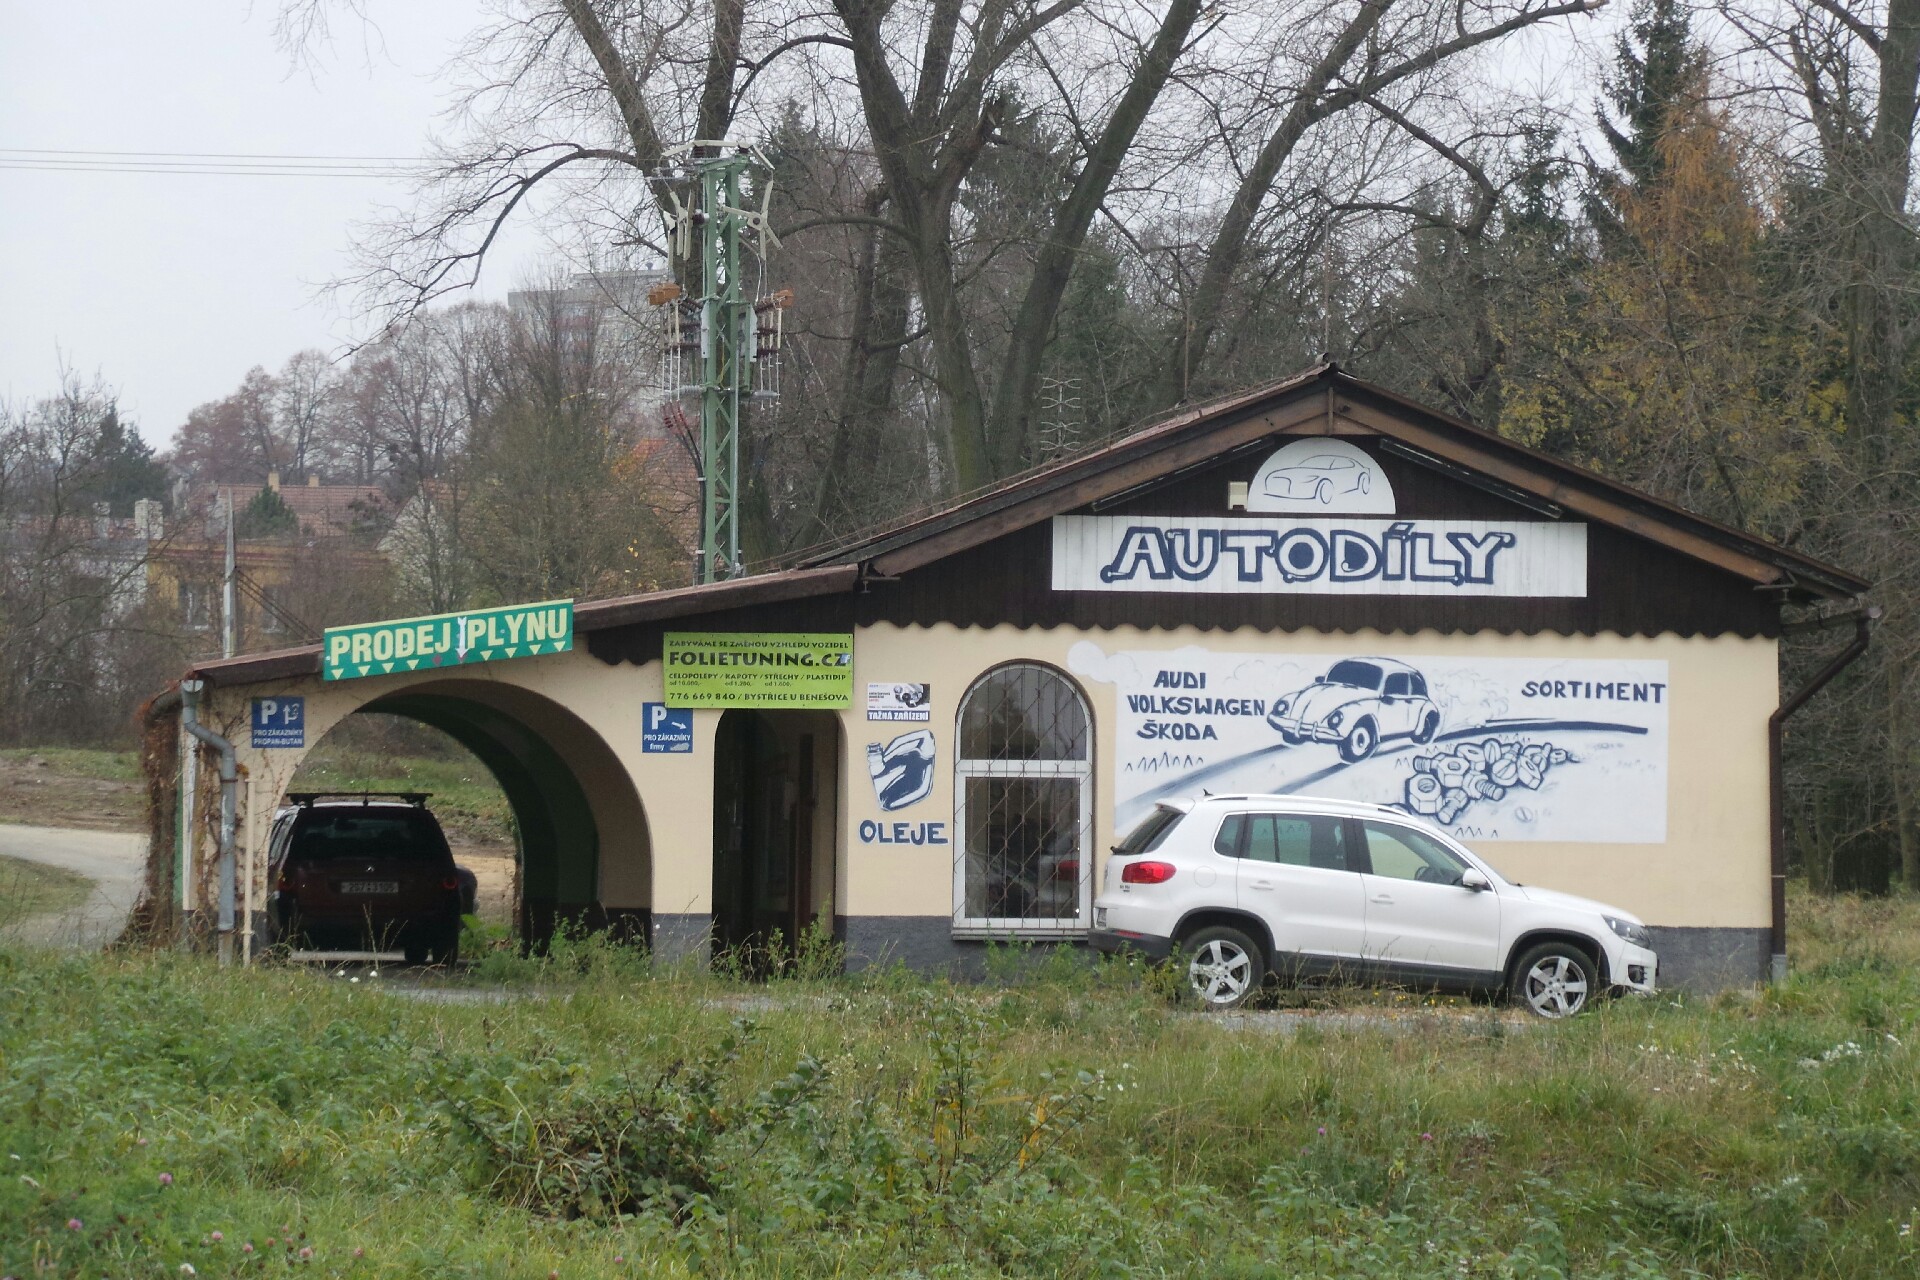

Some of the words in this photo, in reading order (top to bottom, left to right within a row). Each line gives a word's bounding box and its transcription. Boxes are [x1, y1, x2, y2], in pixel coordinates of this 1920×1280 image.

[1100, 522, 1516, 584] AUTODÍLY
[329, 622, 450, 666] PRODEJ
[467, 608, 568, 649] PLYNU
[669, 651, 849, 667] FOLIETUNING.CZ
[1153, 670, 1207, 689] AUDI
[744, 692, 788, 701] BYSTŘICE
[790, 693, 797, 701] U
[799, 692, 849, 701] BENEŠOVA
[1521, 680, 1667, 703] SORTIMENT
[261, 699, 277, 724] P
[868, 711, 893, 720] TAŽNÁ
[893, 711, 929, 720] ZAŘÍZENÍ
[1127, 695, 1266, 716] VOLKSWAGEN
[651, 705, 667, 730] P
[657, 733, 691, 741] ZÁKAZNÍKY
[1137, 719, 1218, 741] ŠKODA
[649, 743, 665, 751] firmy
[859, 819, 949, 846] OLEJE
